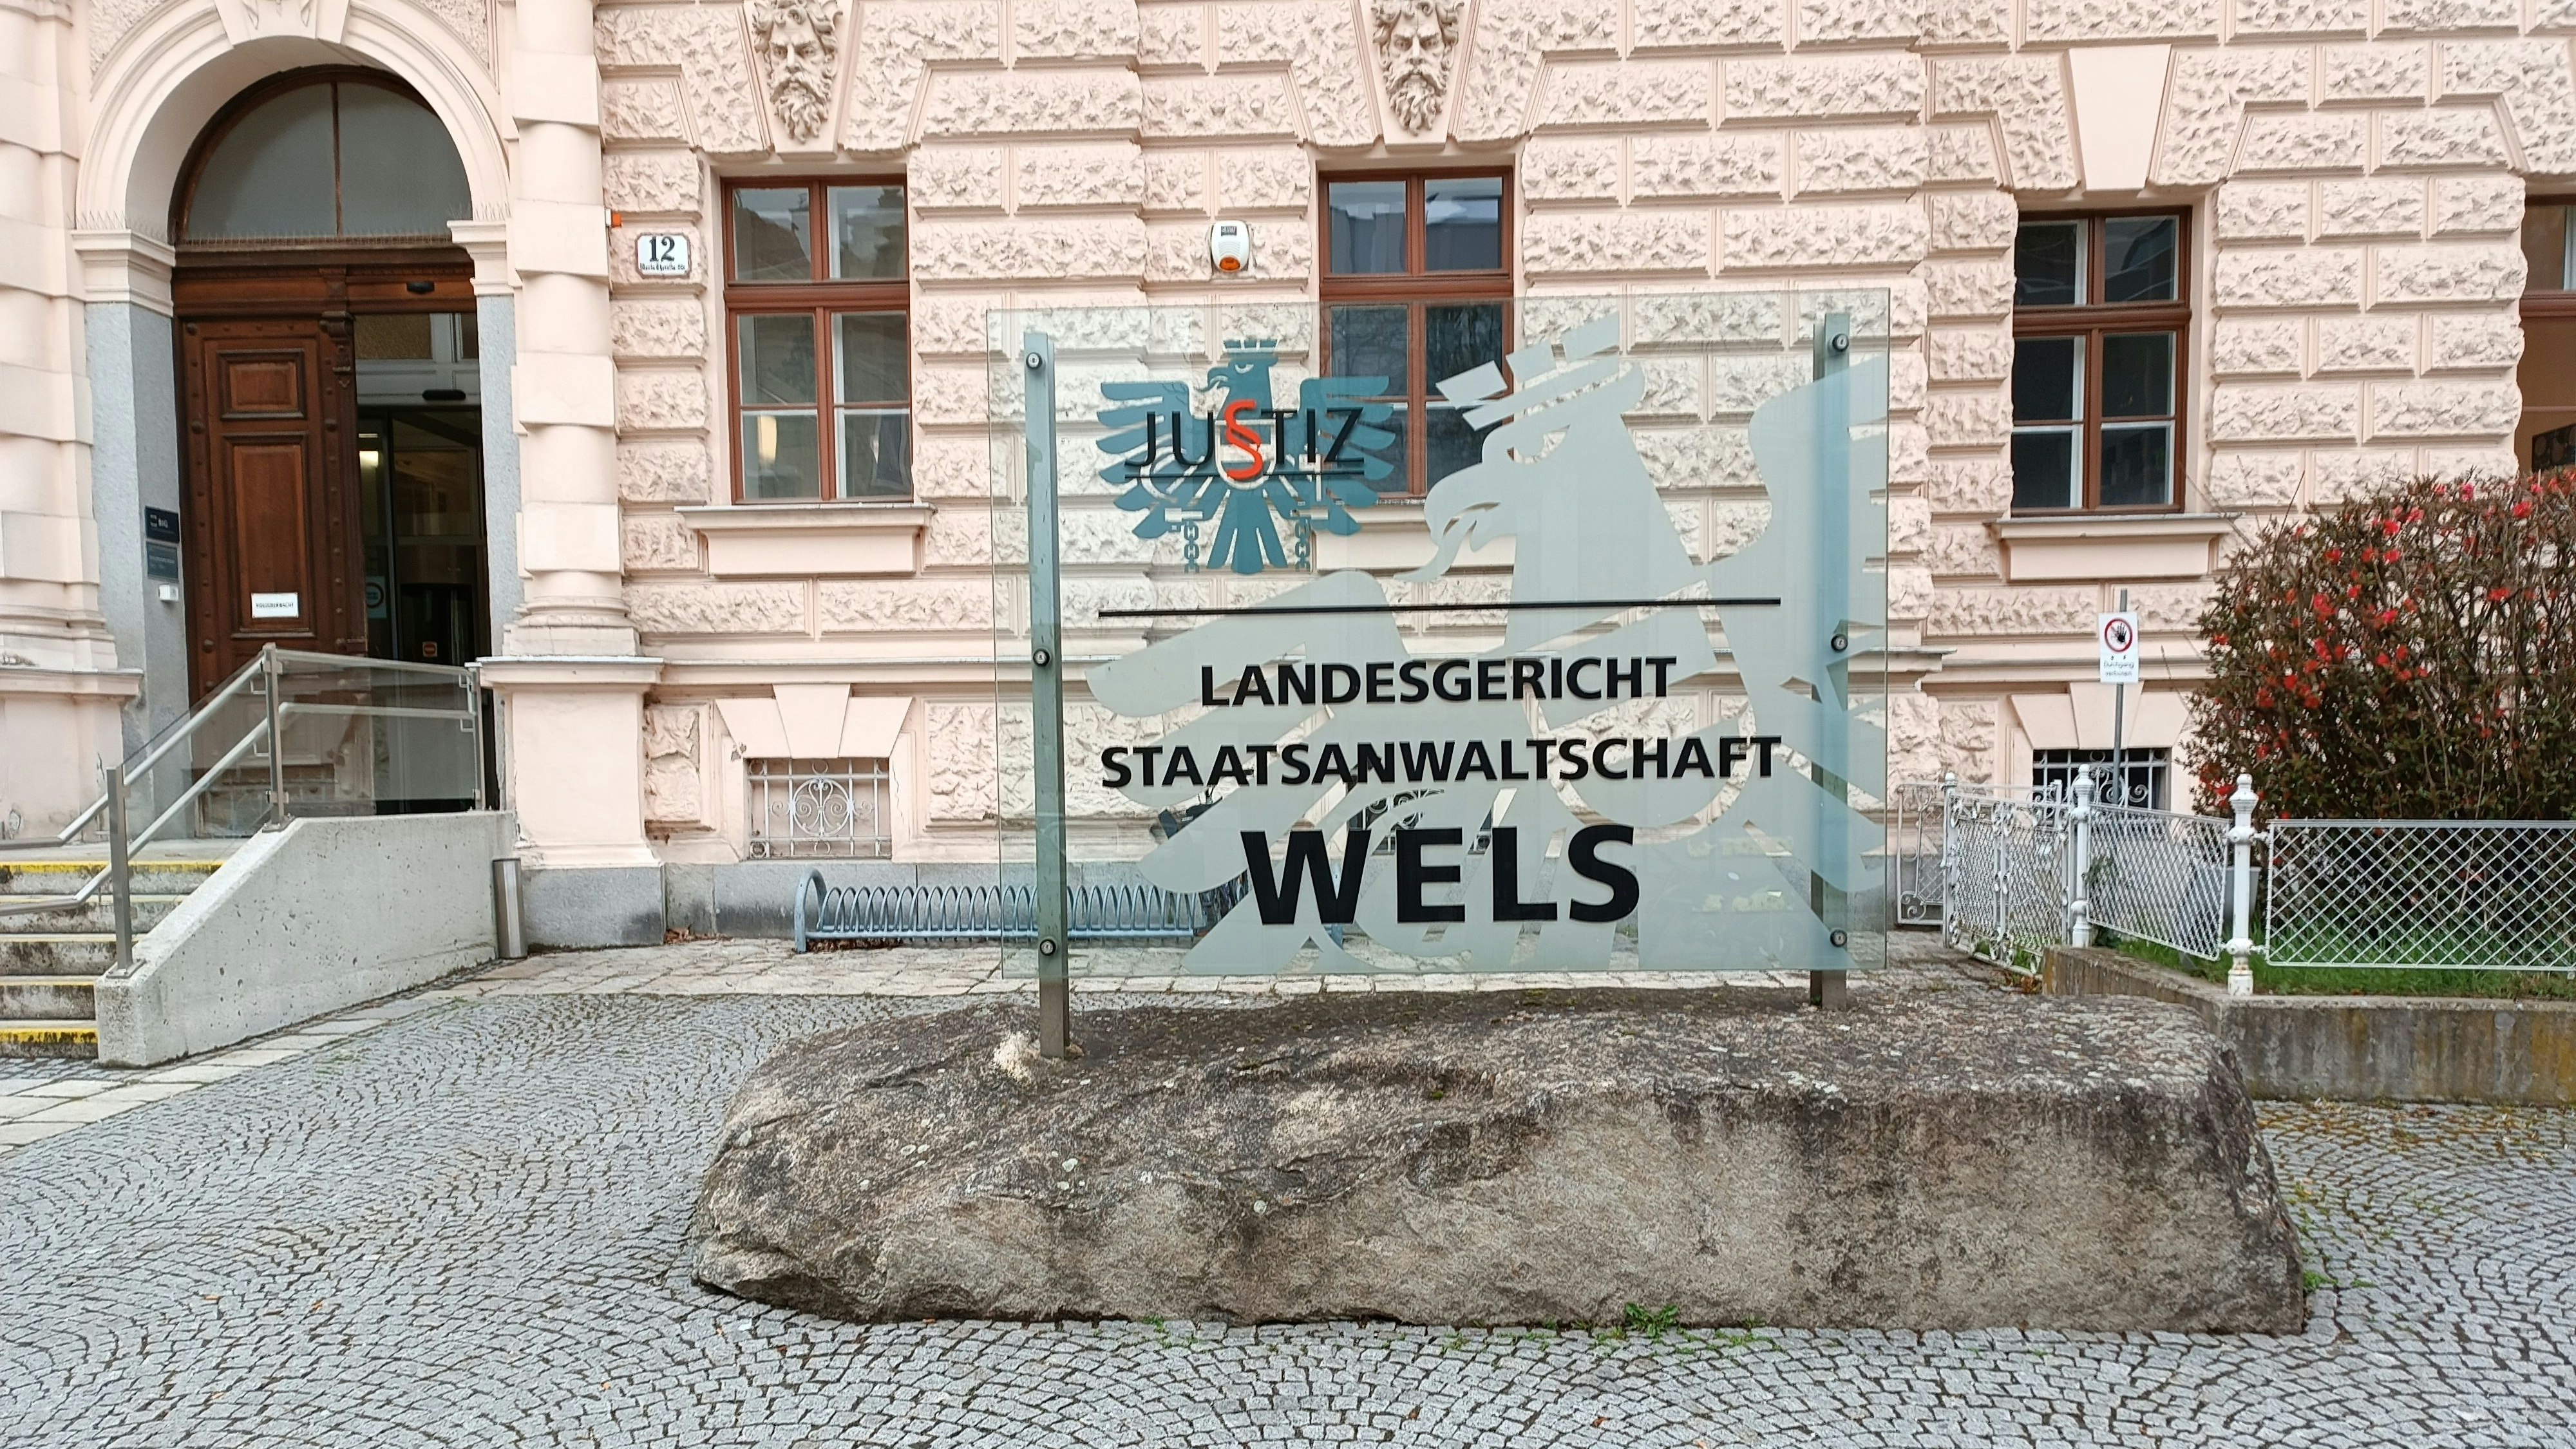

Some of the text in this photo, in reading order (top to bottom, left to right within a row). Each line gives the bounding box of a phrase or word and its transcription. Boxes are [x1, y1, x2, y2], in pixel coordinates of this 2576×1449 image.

[650, 236, 675, 262] 12
[1200, 656, 1677, 707] LANDESGERICHT
[1100, 735, 1782, 789] STAATSANWALTSCHAFT
[1240, 824, 1640, 925] WELS
